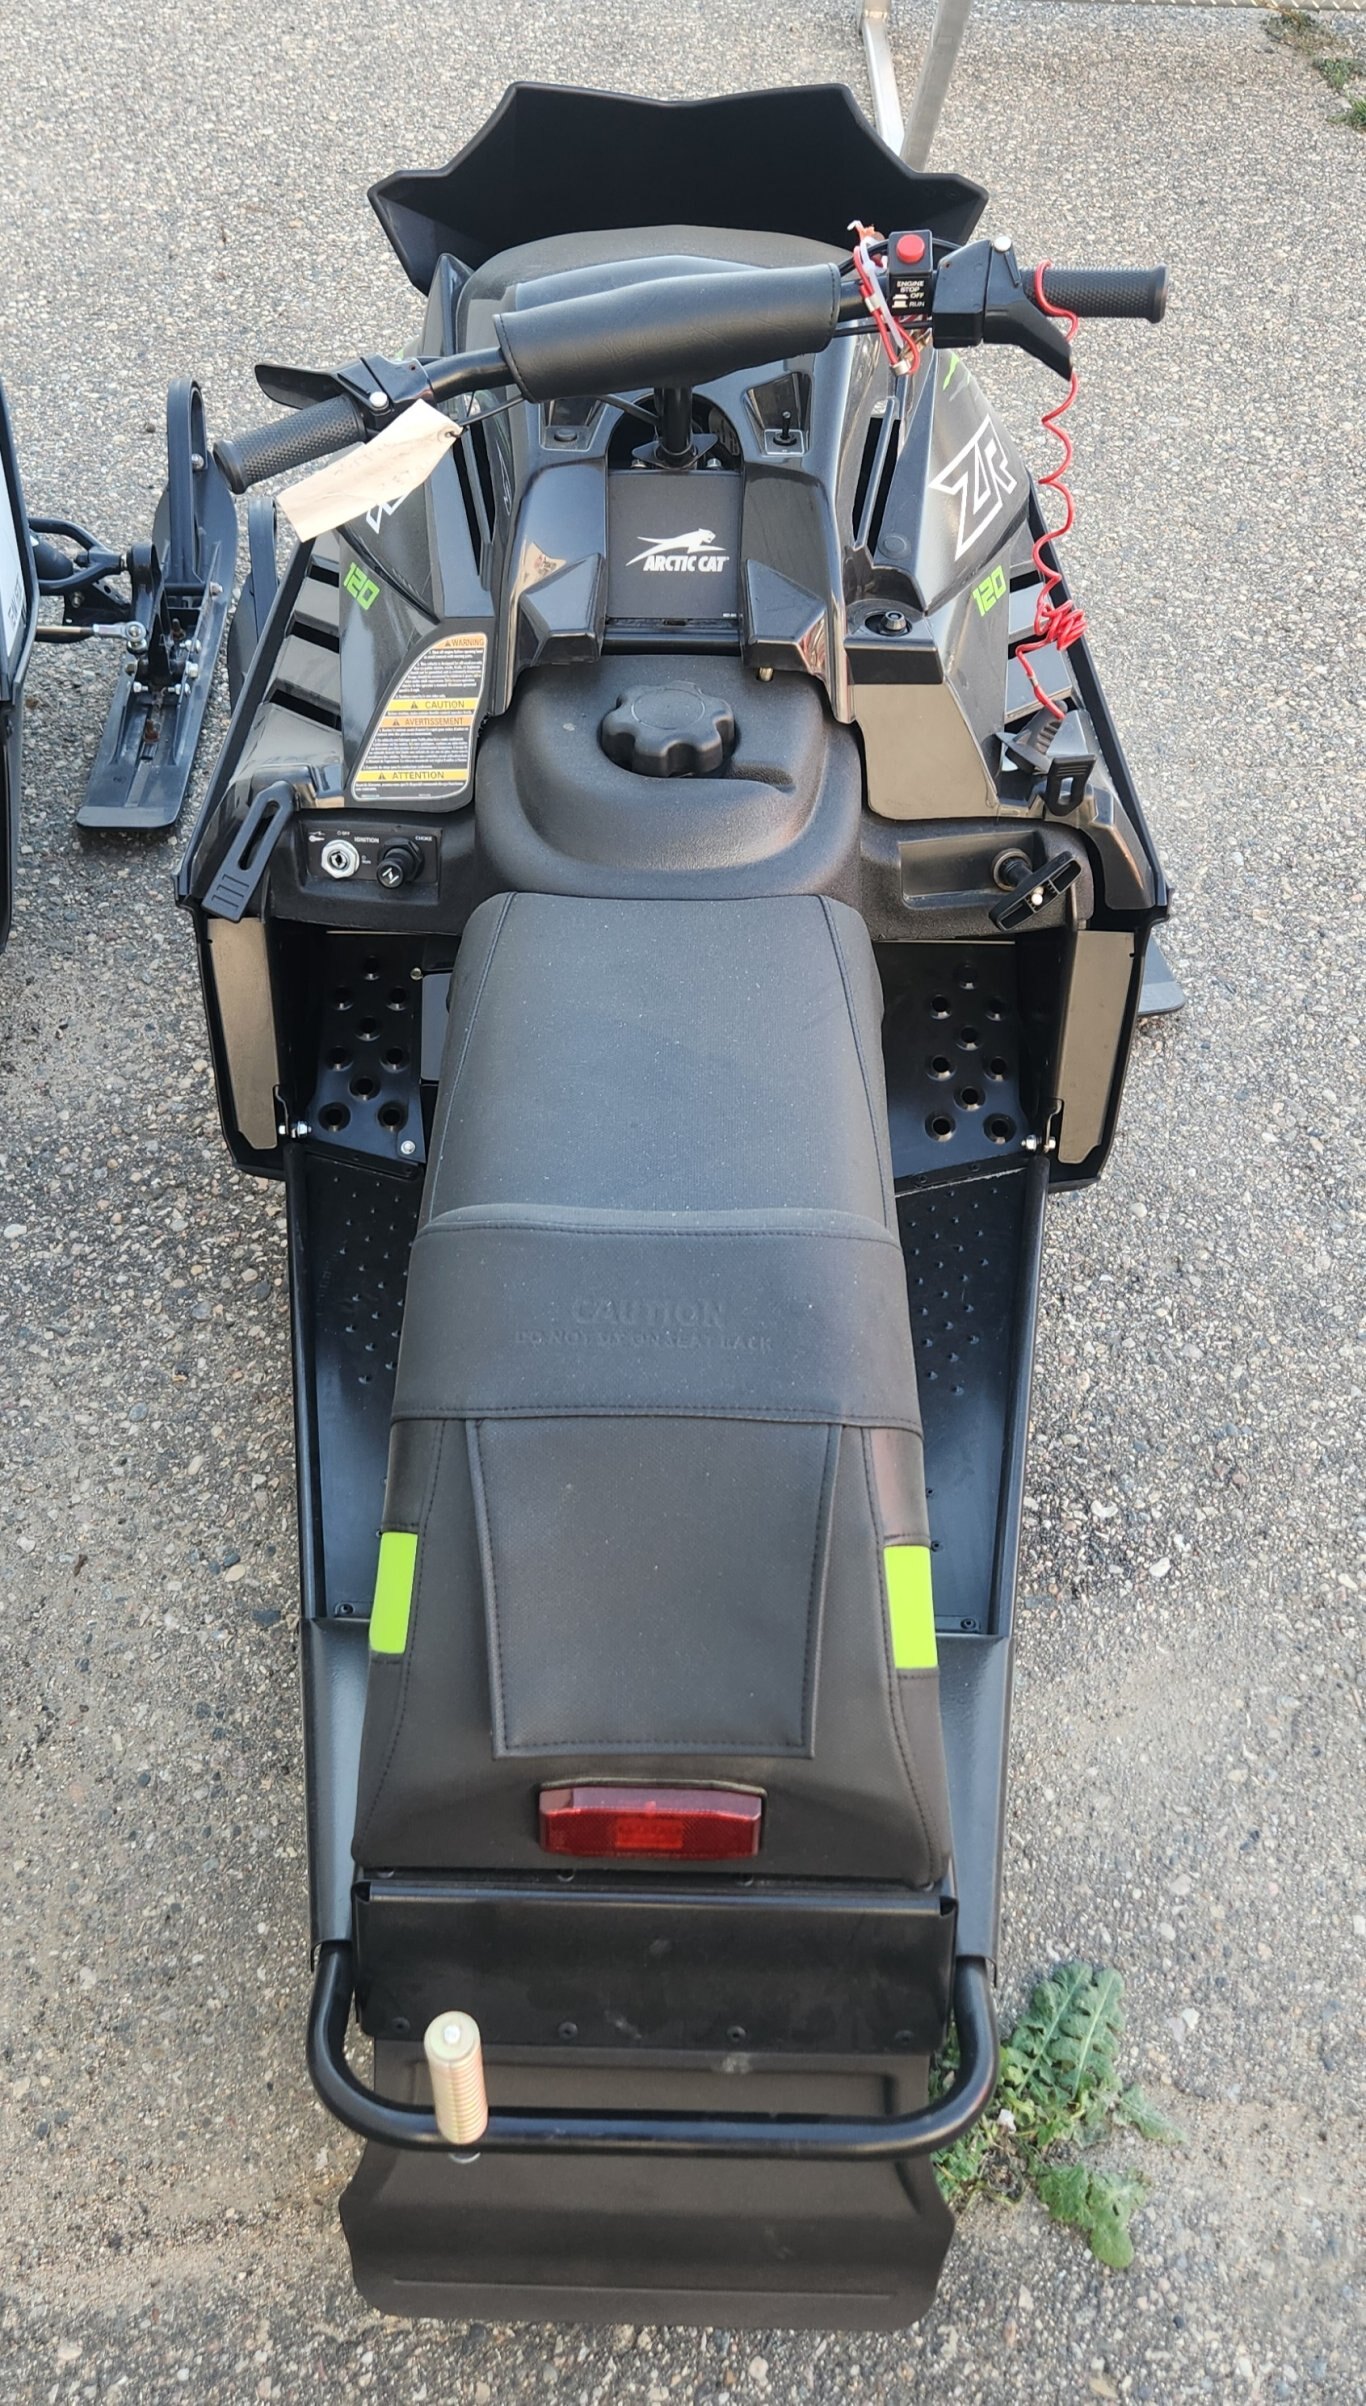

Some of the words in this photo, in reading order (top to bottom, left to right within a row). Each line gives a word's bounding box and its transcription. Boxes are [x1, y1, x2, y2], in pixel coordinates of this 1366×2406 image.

[643, 555, 697, 572] ARCTIC
[698, 555, 725, 573] CAT
[343, 562, 380, 611] 120
[972, 565, 1007, 617] 120
[452, 639, 484, 647] WARNING
[425, 700, 465, 709] CAUTION
[405, 717, 463, 725] AVERTISSEMENT
[392, 771, 445, 780] ATTENTION
[354, 836, 380, 844] IGNITION
[571, 1298, 726, 1328] CAUTION
